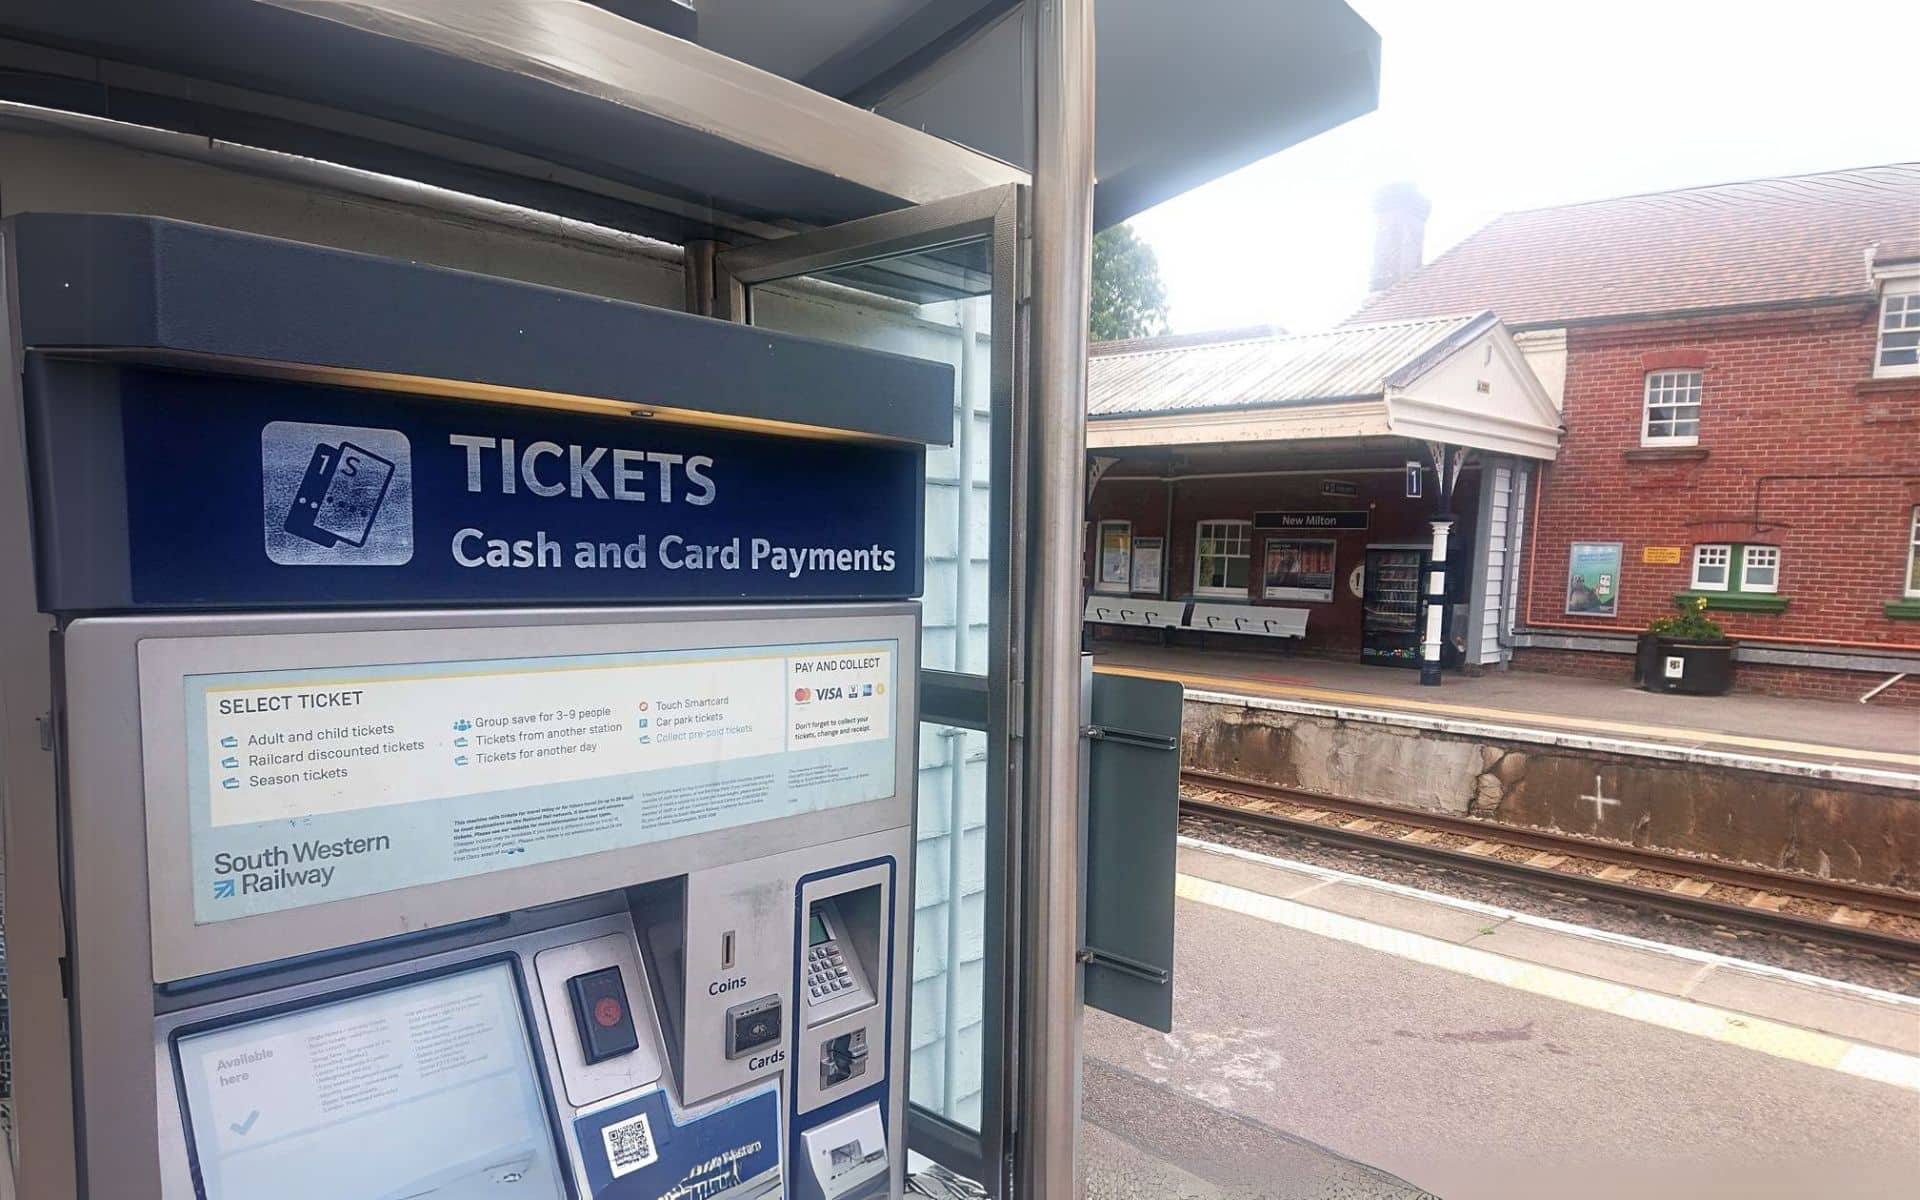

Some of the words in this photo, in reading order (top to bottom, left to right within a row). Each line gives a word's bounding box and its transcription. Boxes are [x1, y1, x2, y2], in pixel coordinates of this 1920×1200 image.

[449, 434, 716, 506] TICKETS
[1282, 515, 1303, 526] New
[1305, 514, 1337, 526] Milton
[451, 527, 562, 569] Cash
[574, 534, 647, 570] and
[658, 536, 740, 570] Card
[751, 538, 896, 578] Payments
[795, 662, 814, 673] PAY
[816, 660, 838, 672] AND
[840, 657, 881, 670] COLLECT
[219, 695, 292, 716] SELECT
[298, 691, 363, 710] TICKET
[656, 699, 682, 711] Touch
[684, 695, 729, 709] Smartcard
[816, 688, 843, 701] VISA
[475, 716, 509, 729] Group
[511, 714, 537, 725] save
[539, 711, 553, 722] for
[578, 706, 611, 720] people
[656, 716, 673, 727] Car
[675, 714, 696, 727] park
[697, 711, 724, 723] tickets
[812, 719, 830, 729] forget
[831, 718, 837, 726] to
[838, 717, 856, 726] collect
[857, 715, 869, 724] your
[248, 731, 285, 747] Adult
[288, 729, 314, 743] and
[316, 725, 349, 741] child
[352, 722, 395, 738] tickets
[476, 731, 516, 746] Tickets
[518, 729, 545, 742] from
[547, 725, 587, 739] another
[588, 722, 623, 735] station
[656, 732, 686, 744] Collect
[688, 727, 725, 743] pre-paid
[726, 724, 753, 737] tickets
[817, 728, 838, 738] change
[839, 726, 850, 734] and
[248, 750, 304, 767] Railcard
[307, 743, 380, 762] discounted
[382, 739, 425, 756] tickets
[476, 750, 517, 764] Tickets
[519, 748, 535, 759] for
[536, 743, 577, 757] another
[579, 741, 598, 754] day
[249, 771, 300, 788] Season
[303, 766, 348, 783] tickets
[213, 845, 289, 876] South
[291, 833, 390, 864] Western
[241, 864, 335, 896] Railway
[708, 976, 747, 996] Coins
[216, 1048, 274, 1073] Available
[749, 1050, 785, 1071] Cards
[219, 1071, 249, 1088] here
